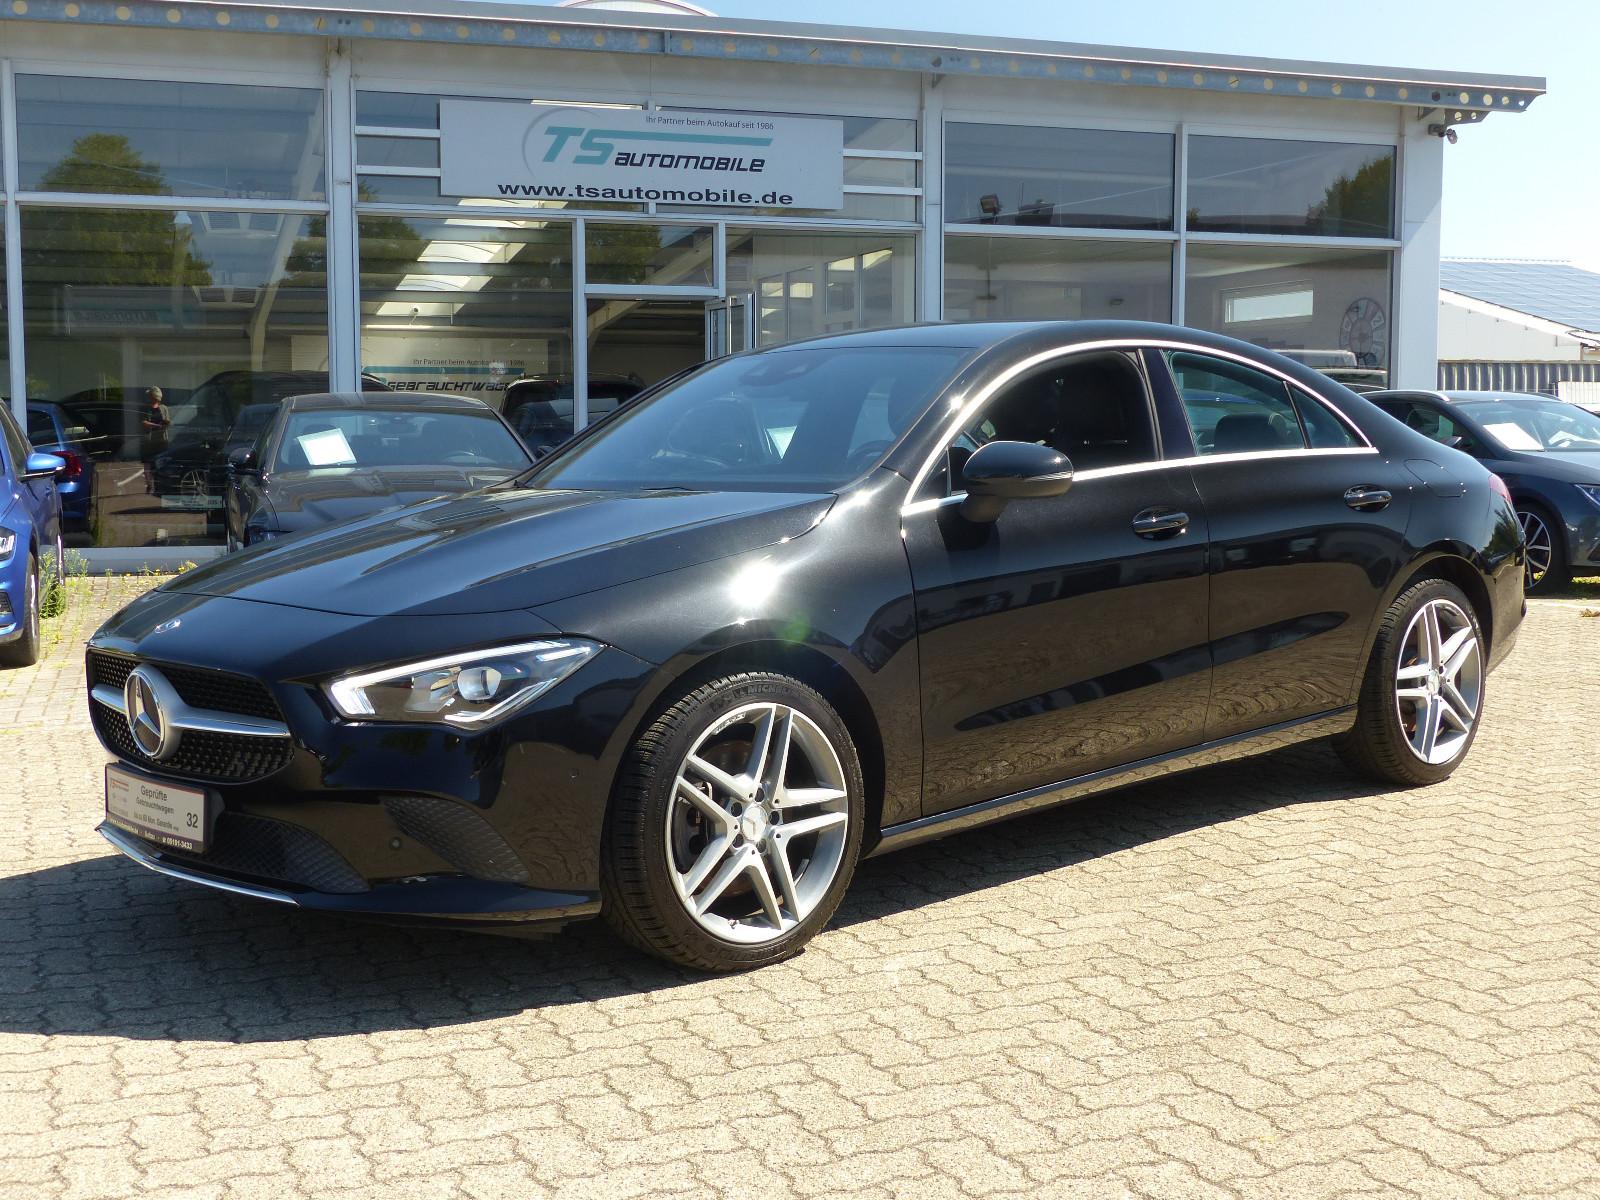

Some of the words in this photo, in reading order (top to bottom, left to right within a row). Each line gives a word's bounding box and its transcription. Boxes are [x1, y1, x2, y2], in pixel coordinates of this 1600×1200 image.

[645, 115, 656, 125] Ihr
[657, 116, 685, 127] Partner
[686, 117, 706, 127] beim
[707, 118, 741, 129] Autokauf
[741, 120, 755, 130] seit
[756, 121, 774, 131] 1986
[542, 126, 615, 165] TS
[497, 184, 794, 205] www.tsautomobile.de
[140, 785, 168, 802] Geprüfte
[186, 812, 199, 829] 32
